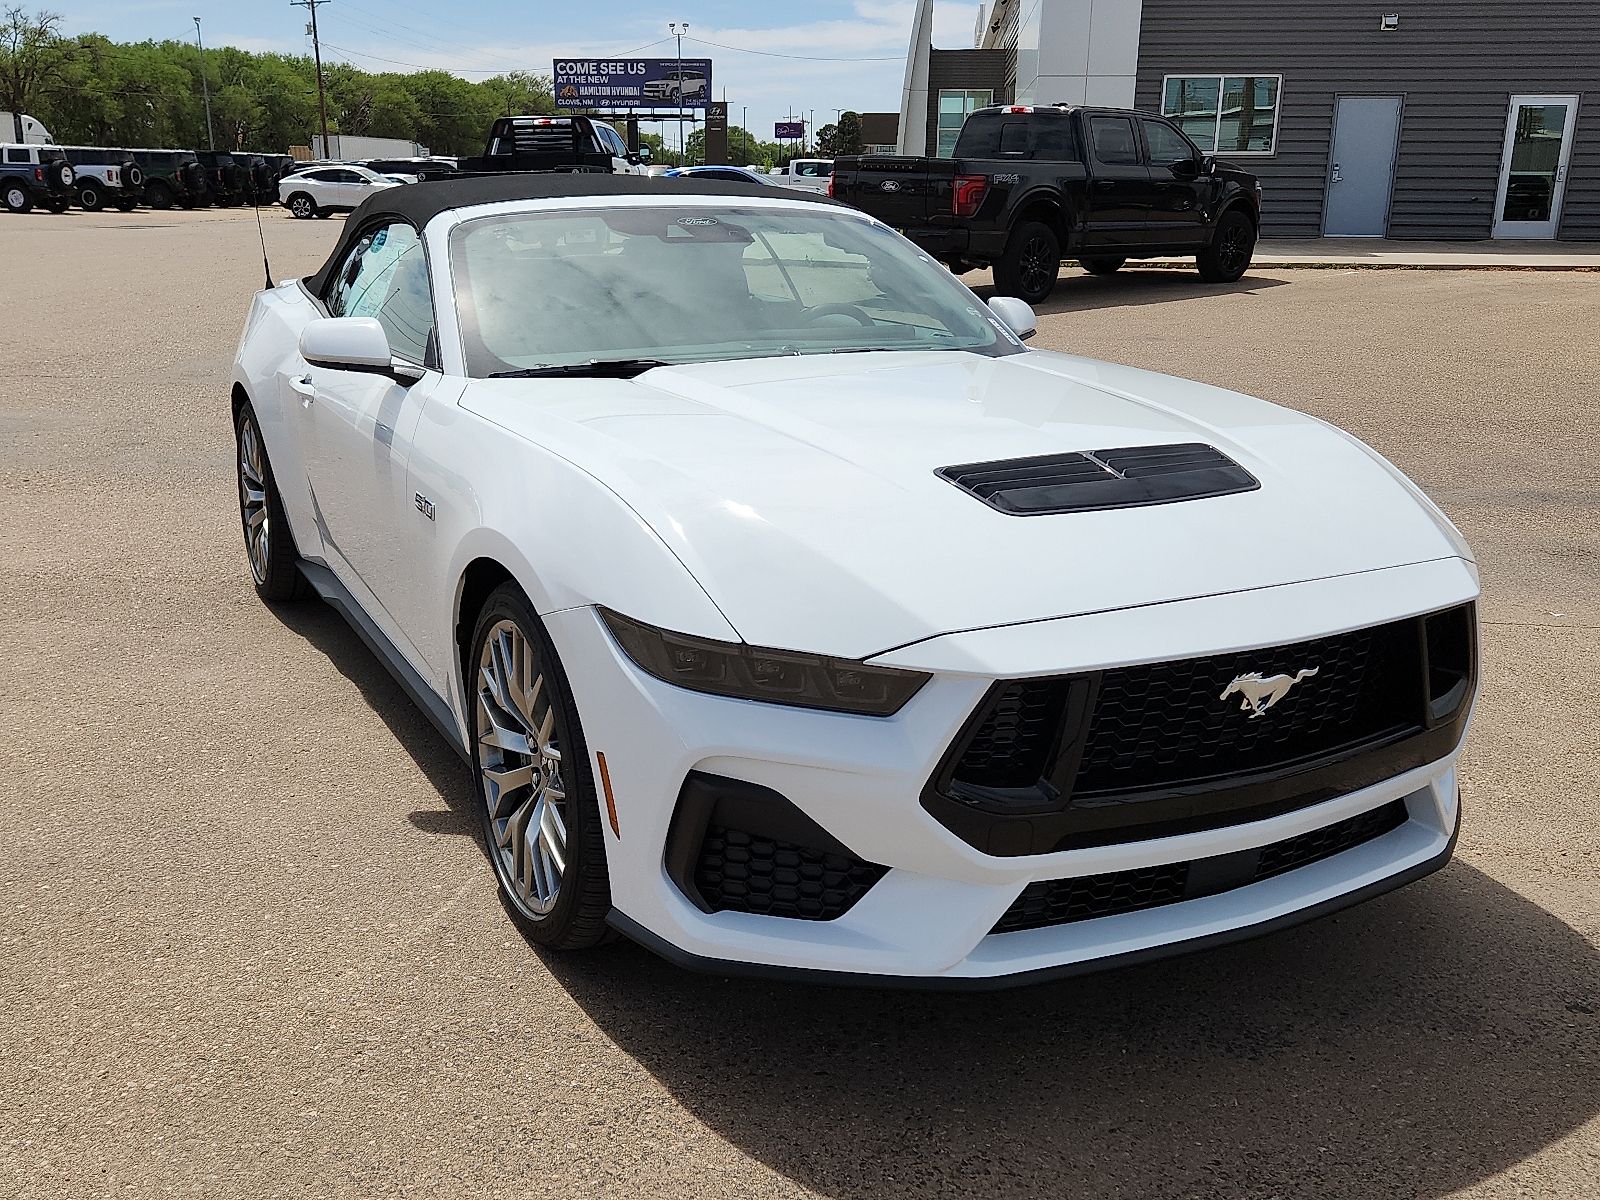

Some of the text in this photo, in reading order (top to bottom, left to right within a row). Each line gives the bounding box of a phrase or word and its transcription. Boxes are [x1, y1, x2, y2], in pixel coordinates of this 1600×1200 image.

[556, 62, 646, 75] COME SEE US
[556, 75, 609, 84] AT THE NEW
[579, 86, 640, 96] HAMILTON HYUNDAI
[582, 98, 594, 106] NM
[993, 173, 1019, 184] FX4
